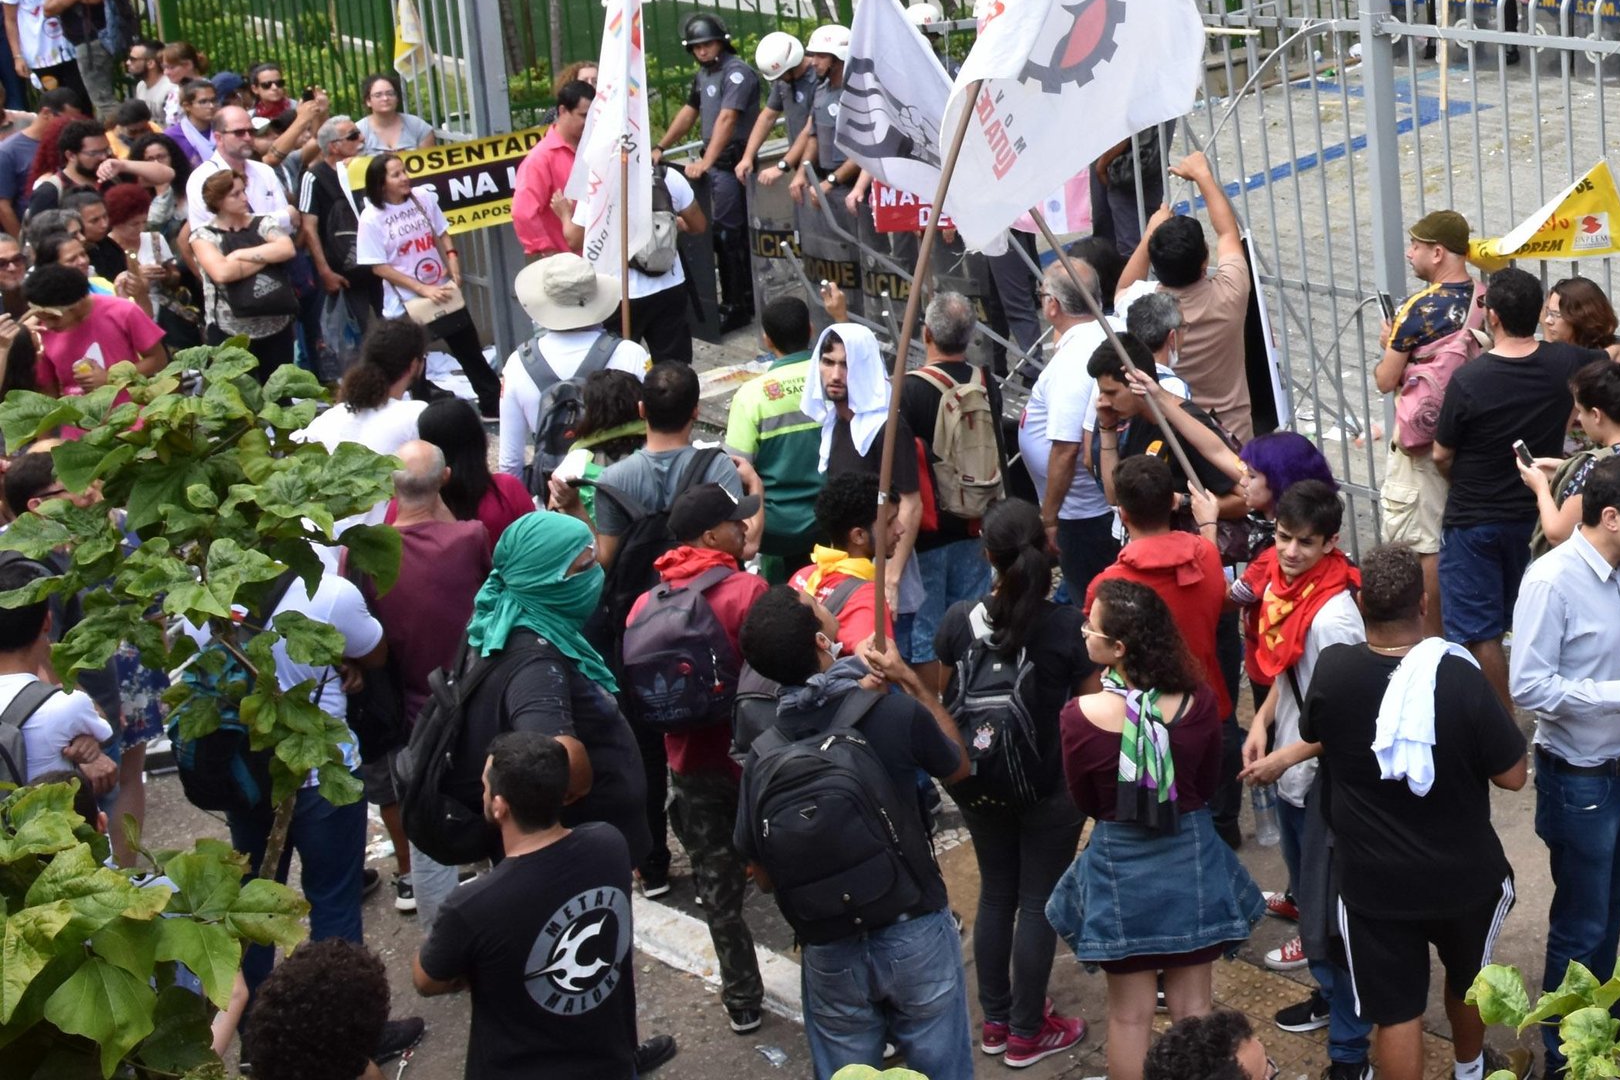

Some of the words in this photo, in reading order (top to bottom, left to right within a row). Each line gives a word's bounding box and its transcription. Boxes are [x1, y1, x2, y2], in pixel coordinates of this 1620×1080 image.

[404, 131, 549, 175] OSENTAD
[448, 171, 499, 202] NA
[545, 889, 617, 938] METAL
